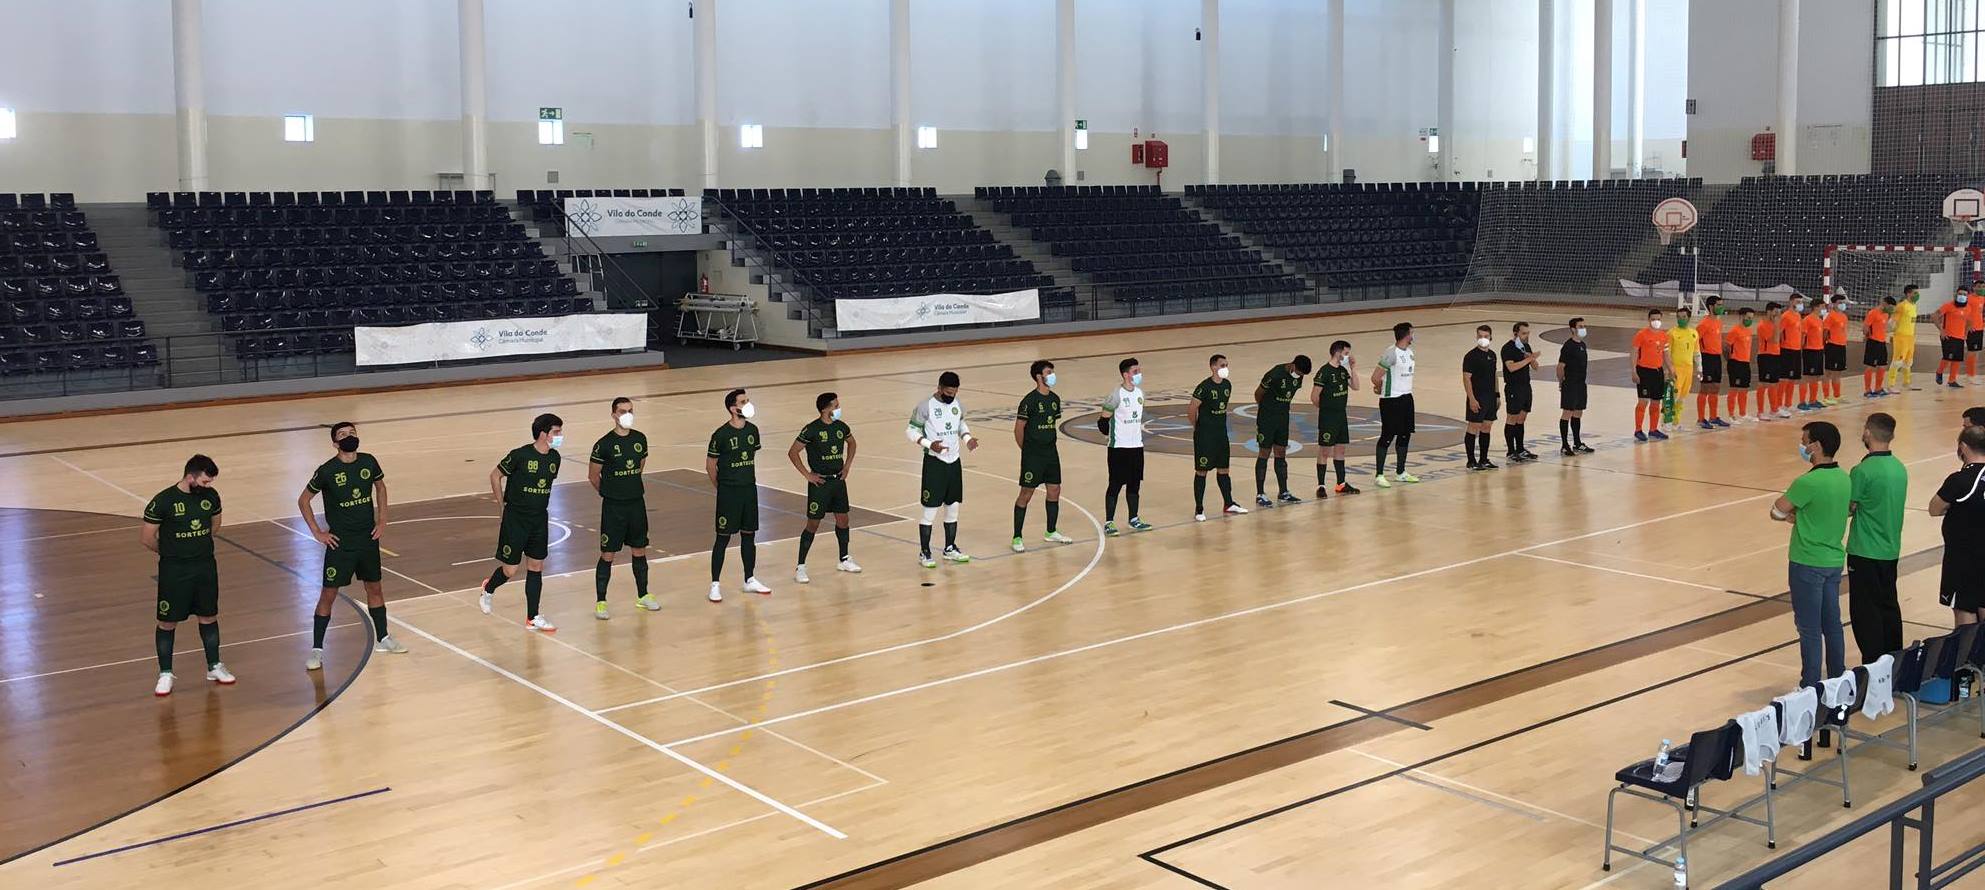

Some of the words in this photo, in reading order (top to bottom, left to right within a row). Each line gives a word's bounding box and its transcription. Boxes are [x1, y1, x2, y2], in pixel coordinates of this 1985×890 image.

[607, 209, 623, 217] Vila
[624, 209, 636, 217] do
[636, 209, 663, 217] Conde
[513, 329, 524, 337] do
[525, 328, 548, 337] Conde
[729, 436, 738, 447] 17
[614, 444, 621, 453] 9
[527, 460, 539, 470] 88
[334, 472, 347, 484] 26
[173, 502, 186, 513] 10
